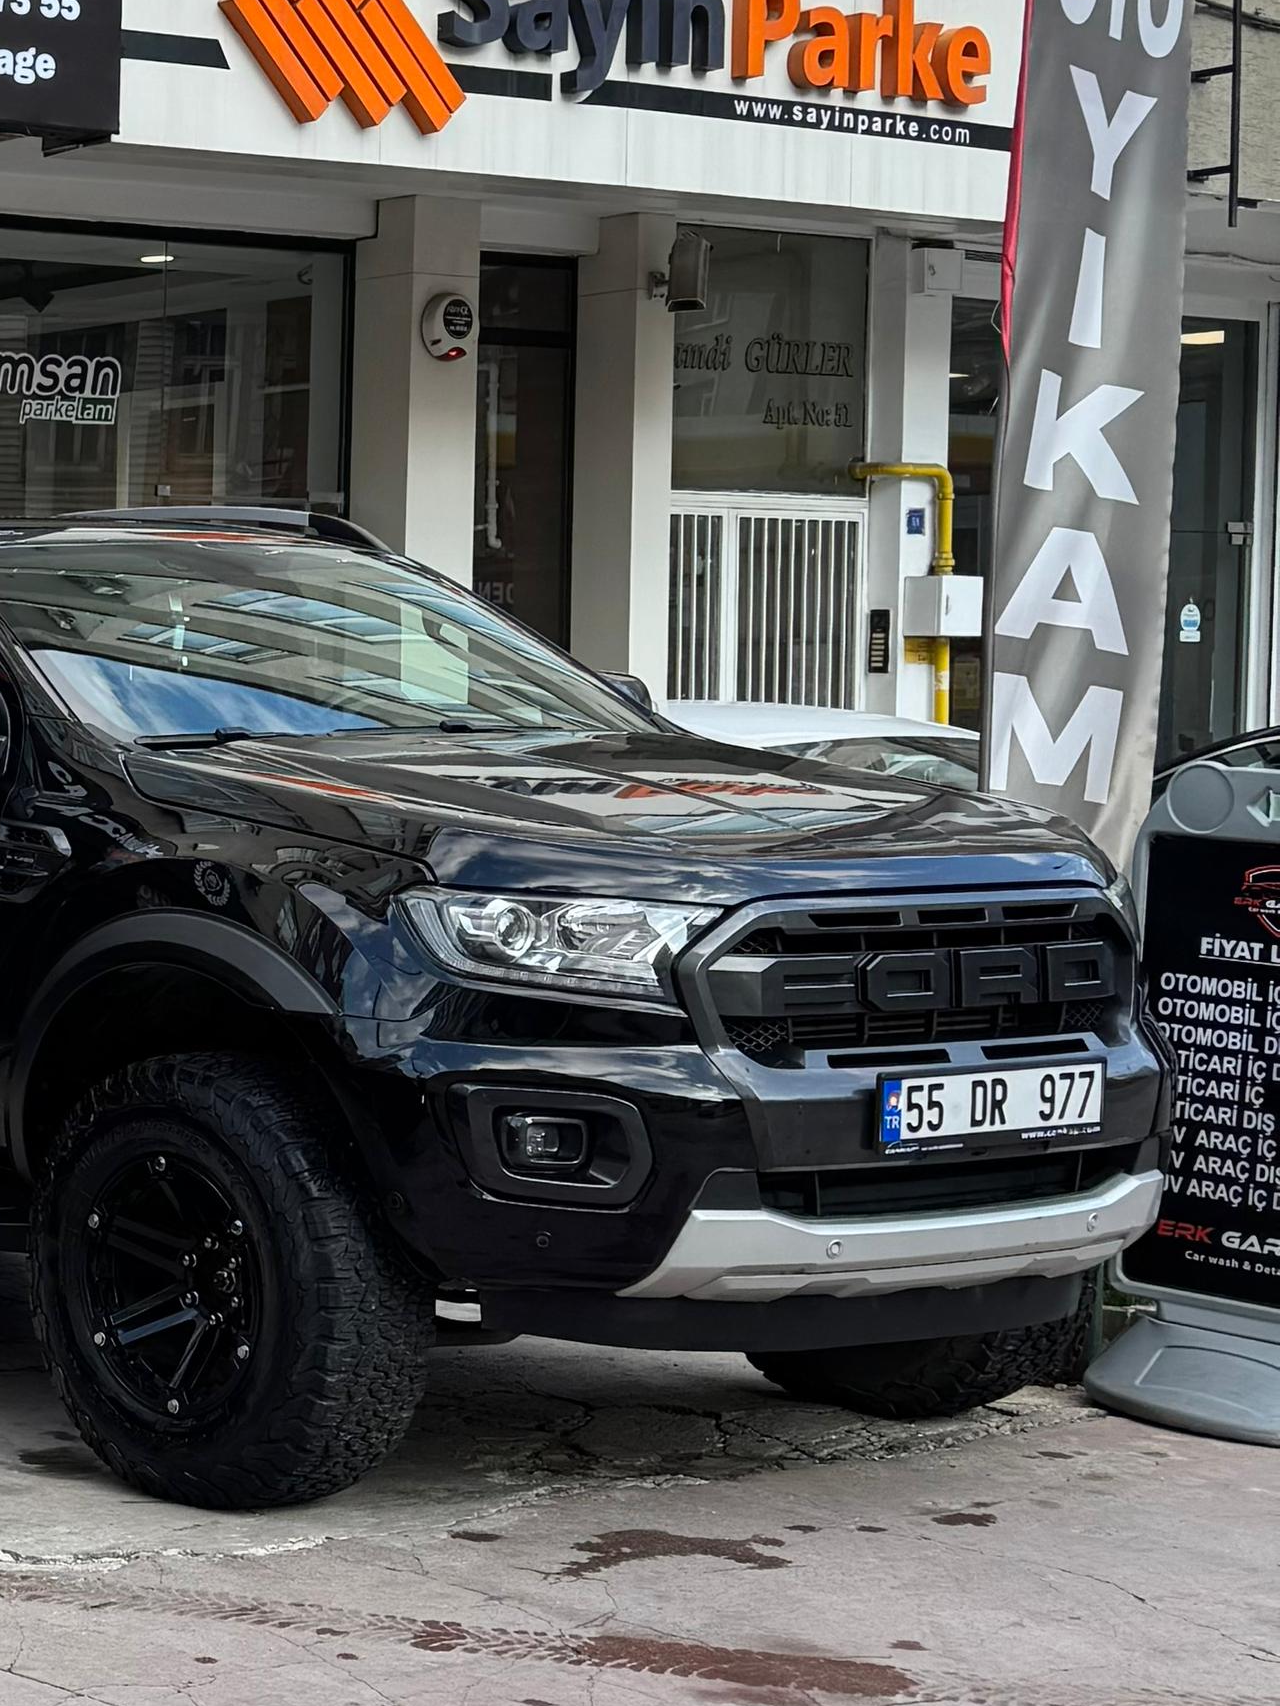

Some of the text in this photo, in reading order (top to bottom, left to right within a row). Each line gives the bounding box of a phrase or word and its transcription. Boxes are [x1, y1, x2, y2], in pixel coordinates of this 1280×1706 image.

[733, 99, 971, 144] www.sayinparke.com
[744, 332, 854, 378] GÜRLER
[19, 396, 118, 424] parkelam
[1200, 933, 1264, 961] FİYAT
[1160, 972, 1263, 1001] OTOMOBİL
[1158, 997, 1261, 1027] OTOMOBİL
[1177, 1047, 1242, 1076] TİCARİ
[1247, 1055, 1267, 1083] İÇ
[884, 1070, 1095, 1133] TR 55 DR 977
[1177, 1072, 1265, 1108] TİCARİ İÇ
[1175, 1097, 1276, 1136] TİCARİ DIŞ
[1194, 1129, 1252, 1158] ARAÇ
[1257, 1134, 1277, 1161] İÇ
[1193, 1154, 1250, 1182] ARAÇ
[1186, 1178, 1243, 1207] ARAÇ
[1248, 1183, 1267, 1211] İÇ
[1157, 1219, 1216, 1244] ERK
[1185, 1250, 1205, 1261] Car
[1208, 1256, 1239, 1268] wash
